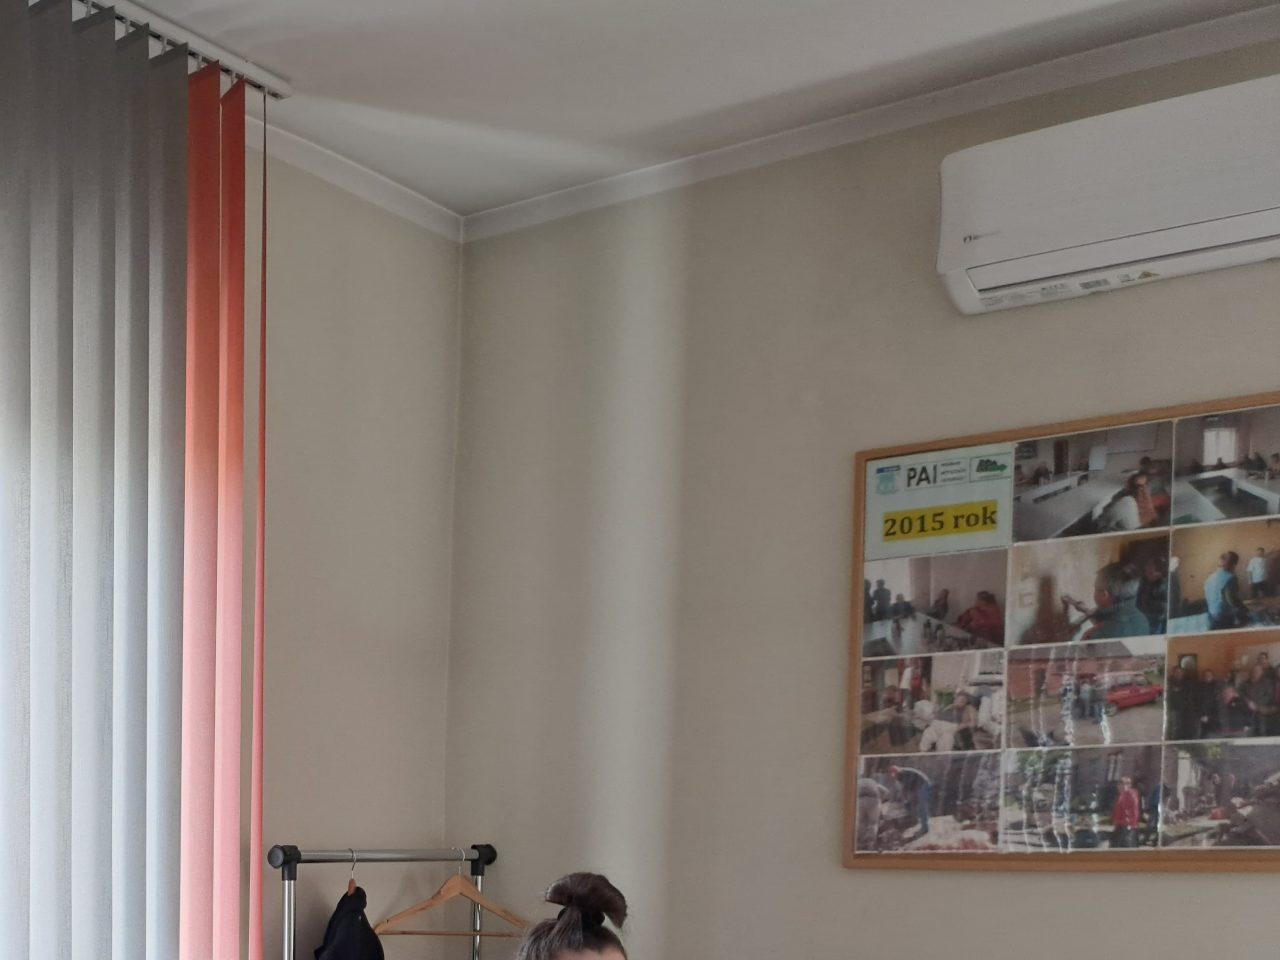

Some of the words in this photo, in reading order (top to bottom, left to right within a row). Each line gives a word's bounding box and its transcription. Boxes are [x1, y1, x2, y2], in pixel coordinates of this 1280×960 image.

[906, 464, 938, 488] PAI
[883, 511, 945, 537] 2015
[952, 506, 998, 529] rok
